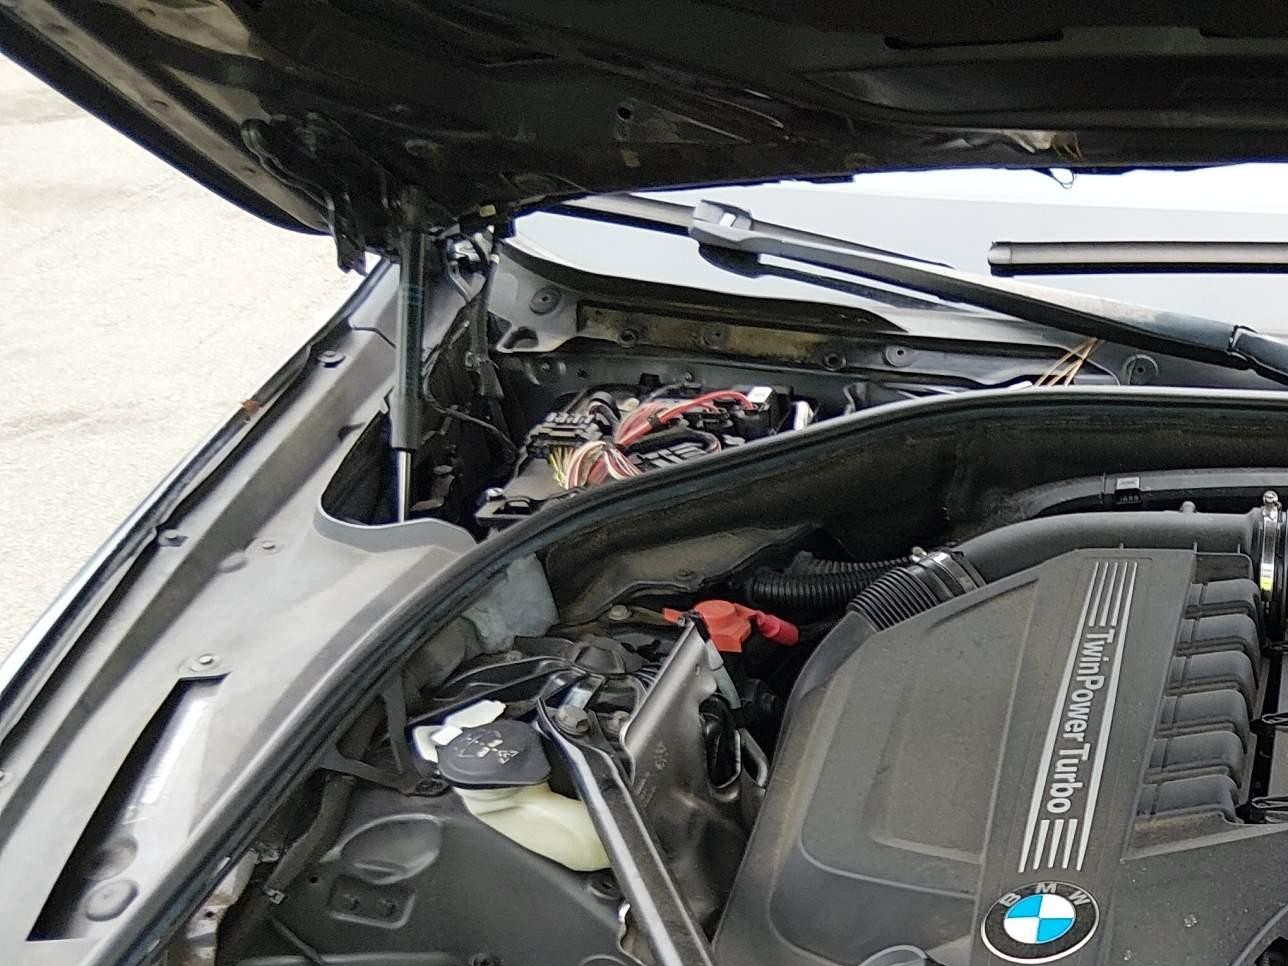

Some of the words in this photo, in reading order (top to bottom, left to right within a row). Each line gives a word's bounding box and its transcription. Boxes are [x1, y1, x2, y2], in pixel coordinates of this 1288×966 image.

[1063, 628, 1116, 743] TwinPower
[1046, 743, 1092, 814] Turbo
[999, 882, 1091, 908] BMW
